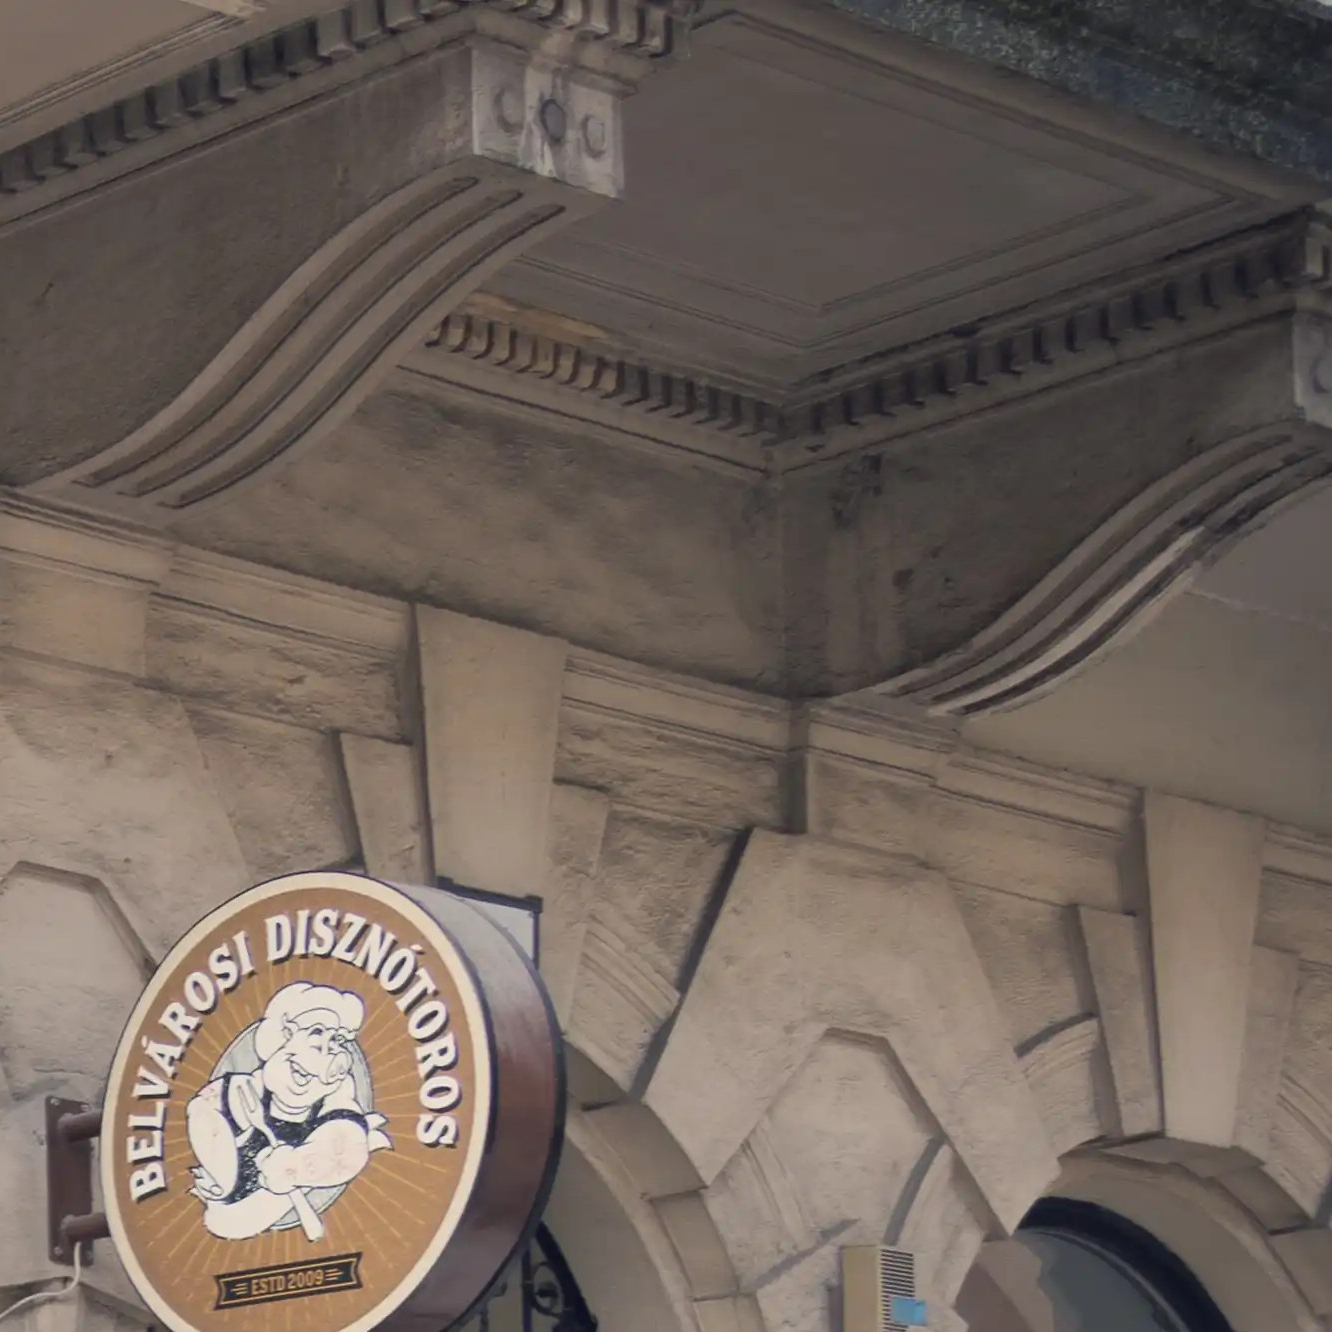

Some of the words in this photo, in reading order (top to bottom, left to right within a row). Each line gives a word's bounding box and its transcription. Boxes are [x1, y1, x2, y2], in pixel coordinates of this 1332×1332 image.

[125, 930, 258, 1204] BELVÁROSI
[264, 908, 465, 1148] DISZNÓTOROS
[251, 1275, 286, 1296] ESTD
[288, 1269, 324, 1290] 2009
